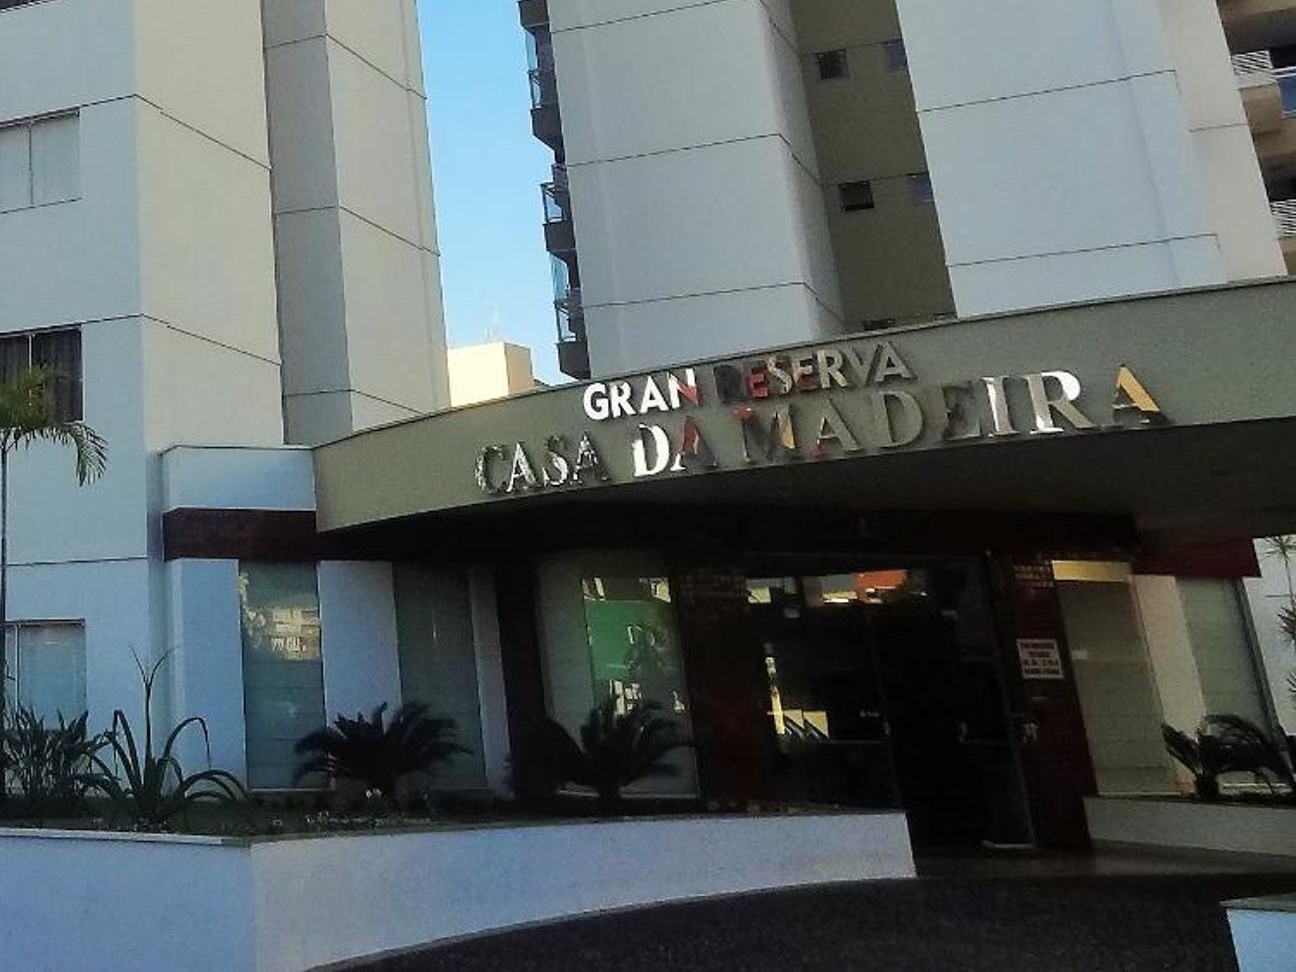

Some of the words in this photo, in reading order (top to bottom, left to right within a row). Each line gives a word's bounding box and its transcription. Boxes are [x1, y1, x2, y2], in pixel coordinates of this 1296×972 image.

[583, 368, 701, 421] GRAN
[475, 430, 609, 494] CASA
[632, 415, 718, 478] DA
